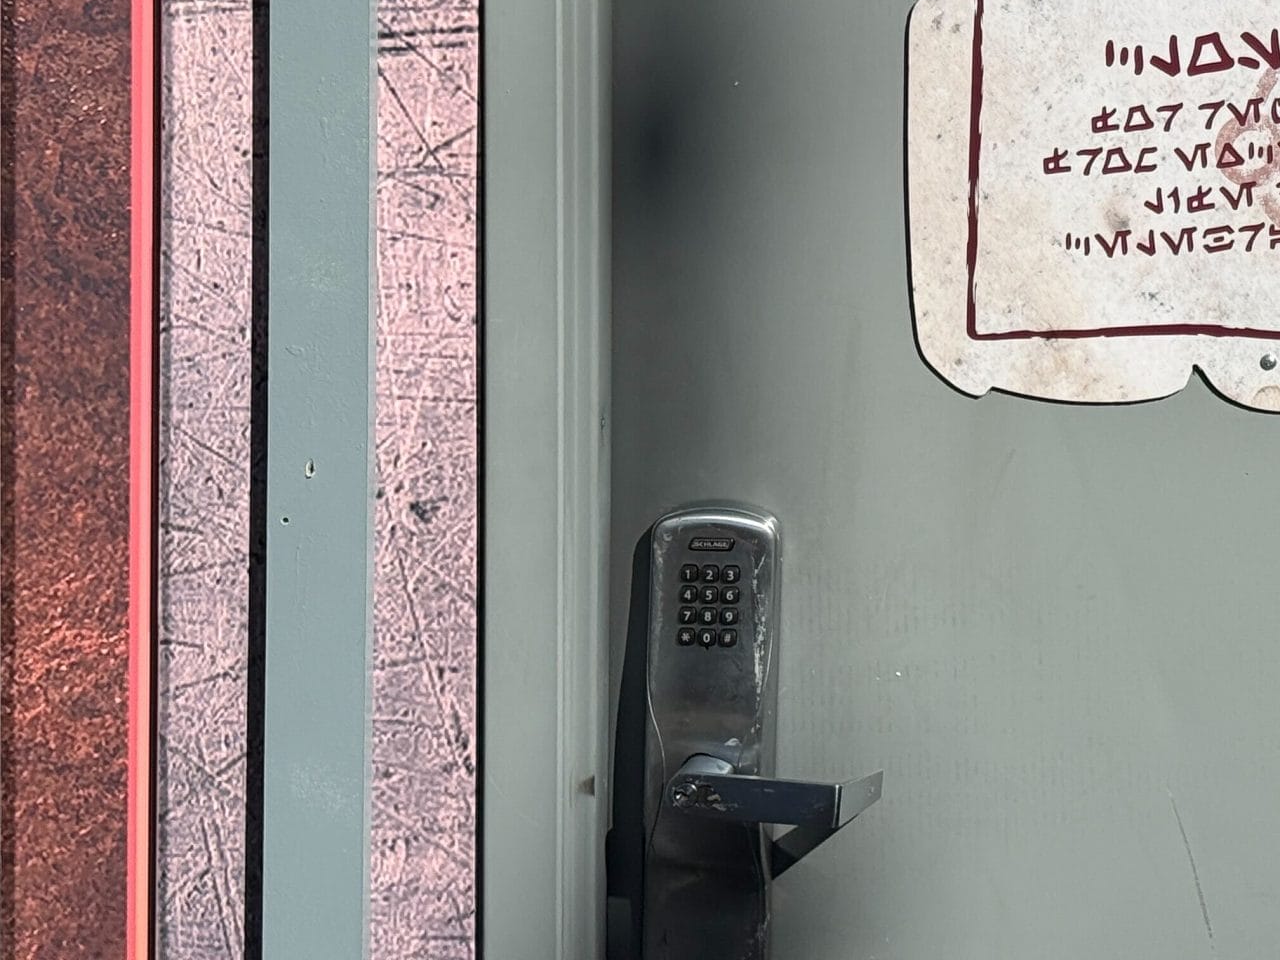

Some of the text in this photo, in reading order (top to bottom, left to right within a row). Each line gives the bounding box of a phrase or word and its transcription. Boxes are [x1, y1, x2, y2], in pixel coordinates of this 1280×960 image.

[705, 569, 714, 580] 2
[726, 570, 735, 581] 3
[683, 589, 734, 601] 4 5 6
[683, 611, 734, 622] 7 8 9
[702, 633, 711, 643] 0
